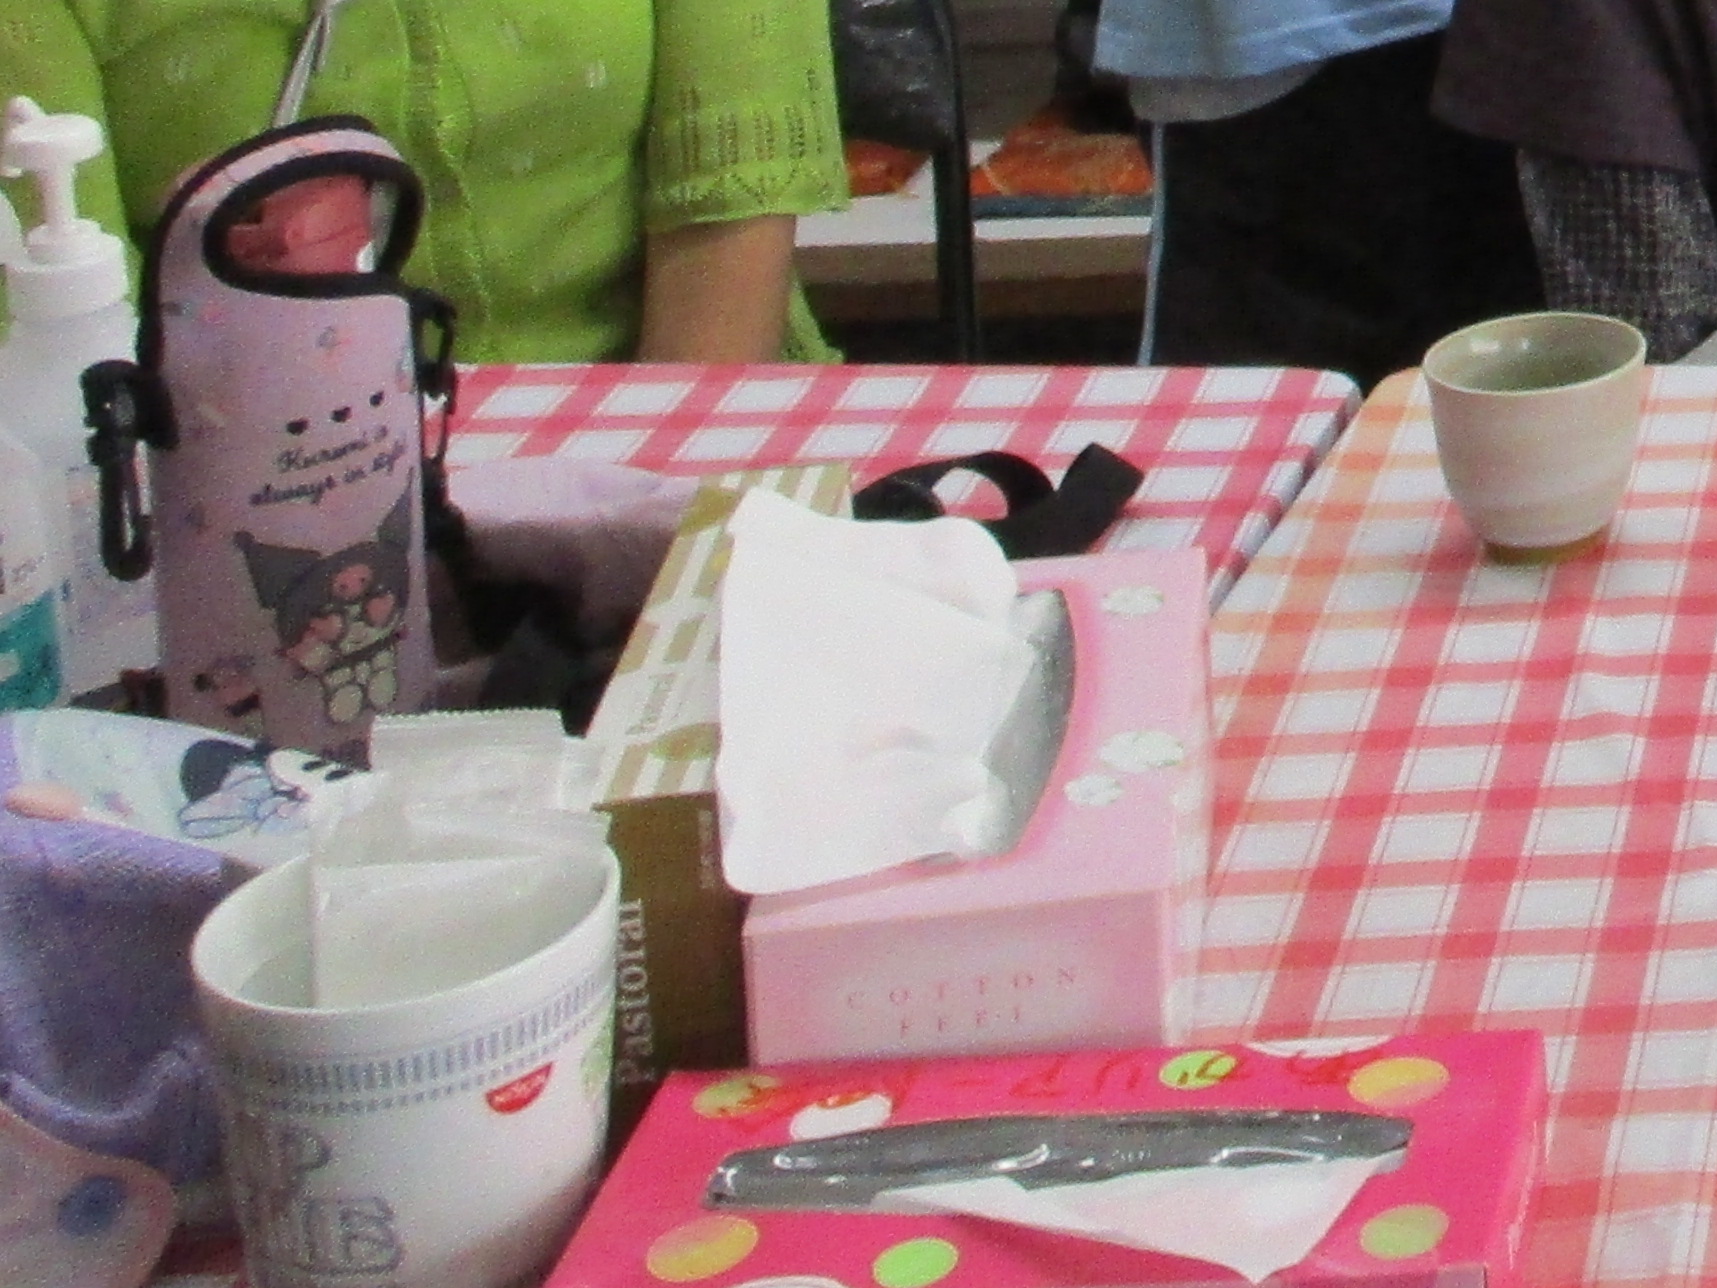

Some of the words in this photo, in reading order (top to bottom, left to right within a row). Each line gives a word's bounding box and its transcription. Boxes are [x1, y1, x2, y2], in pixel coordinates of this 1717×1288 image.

[277, 430, 369, 473] Kuromi
[249, 474, 338, 506] always
[846, 966, 1077, 1010] COTTON
